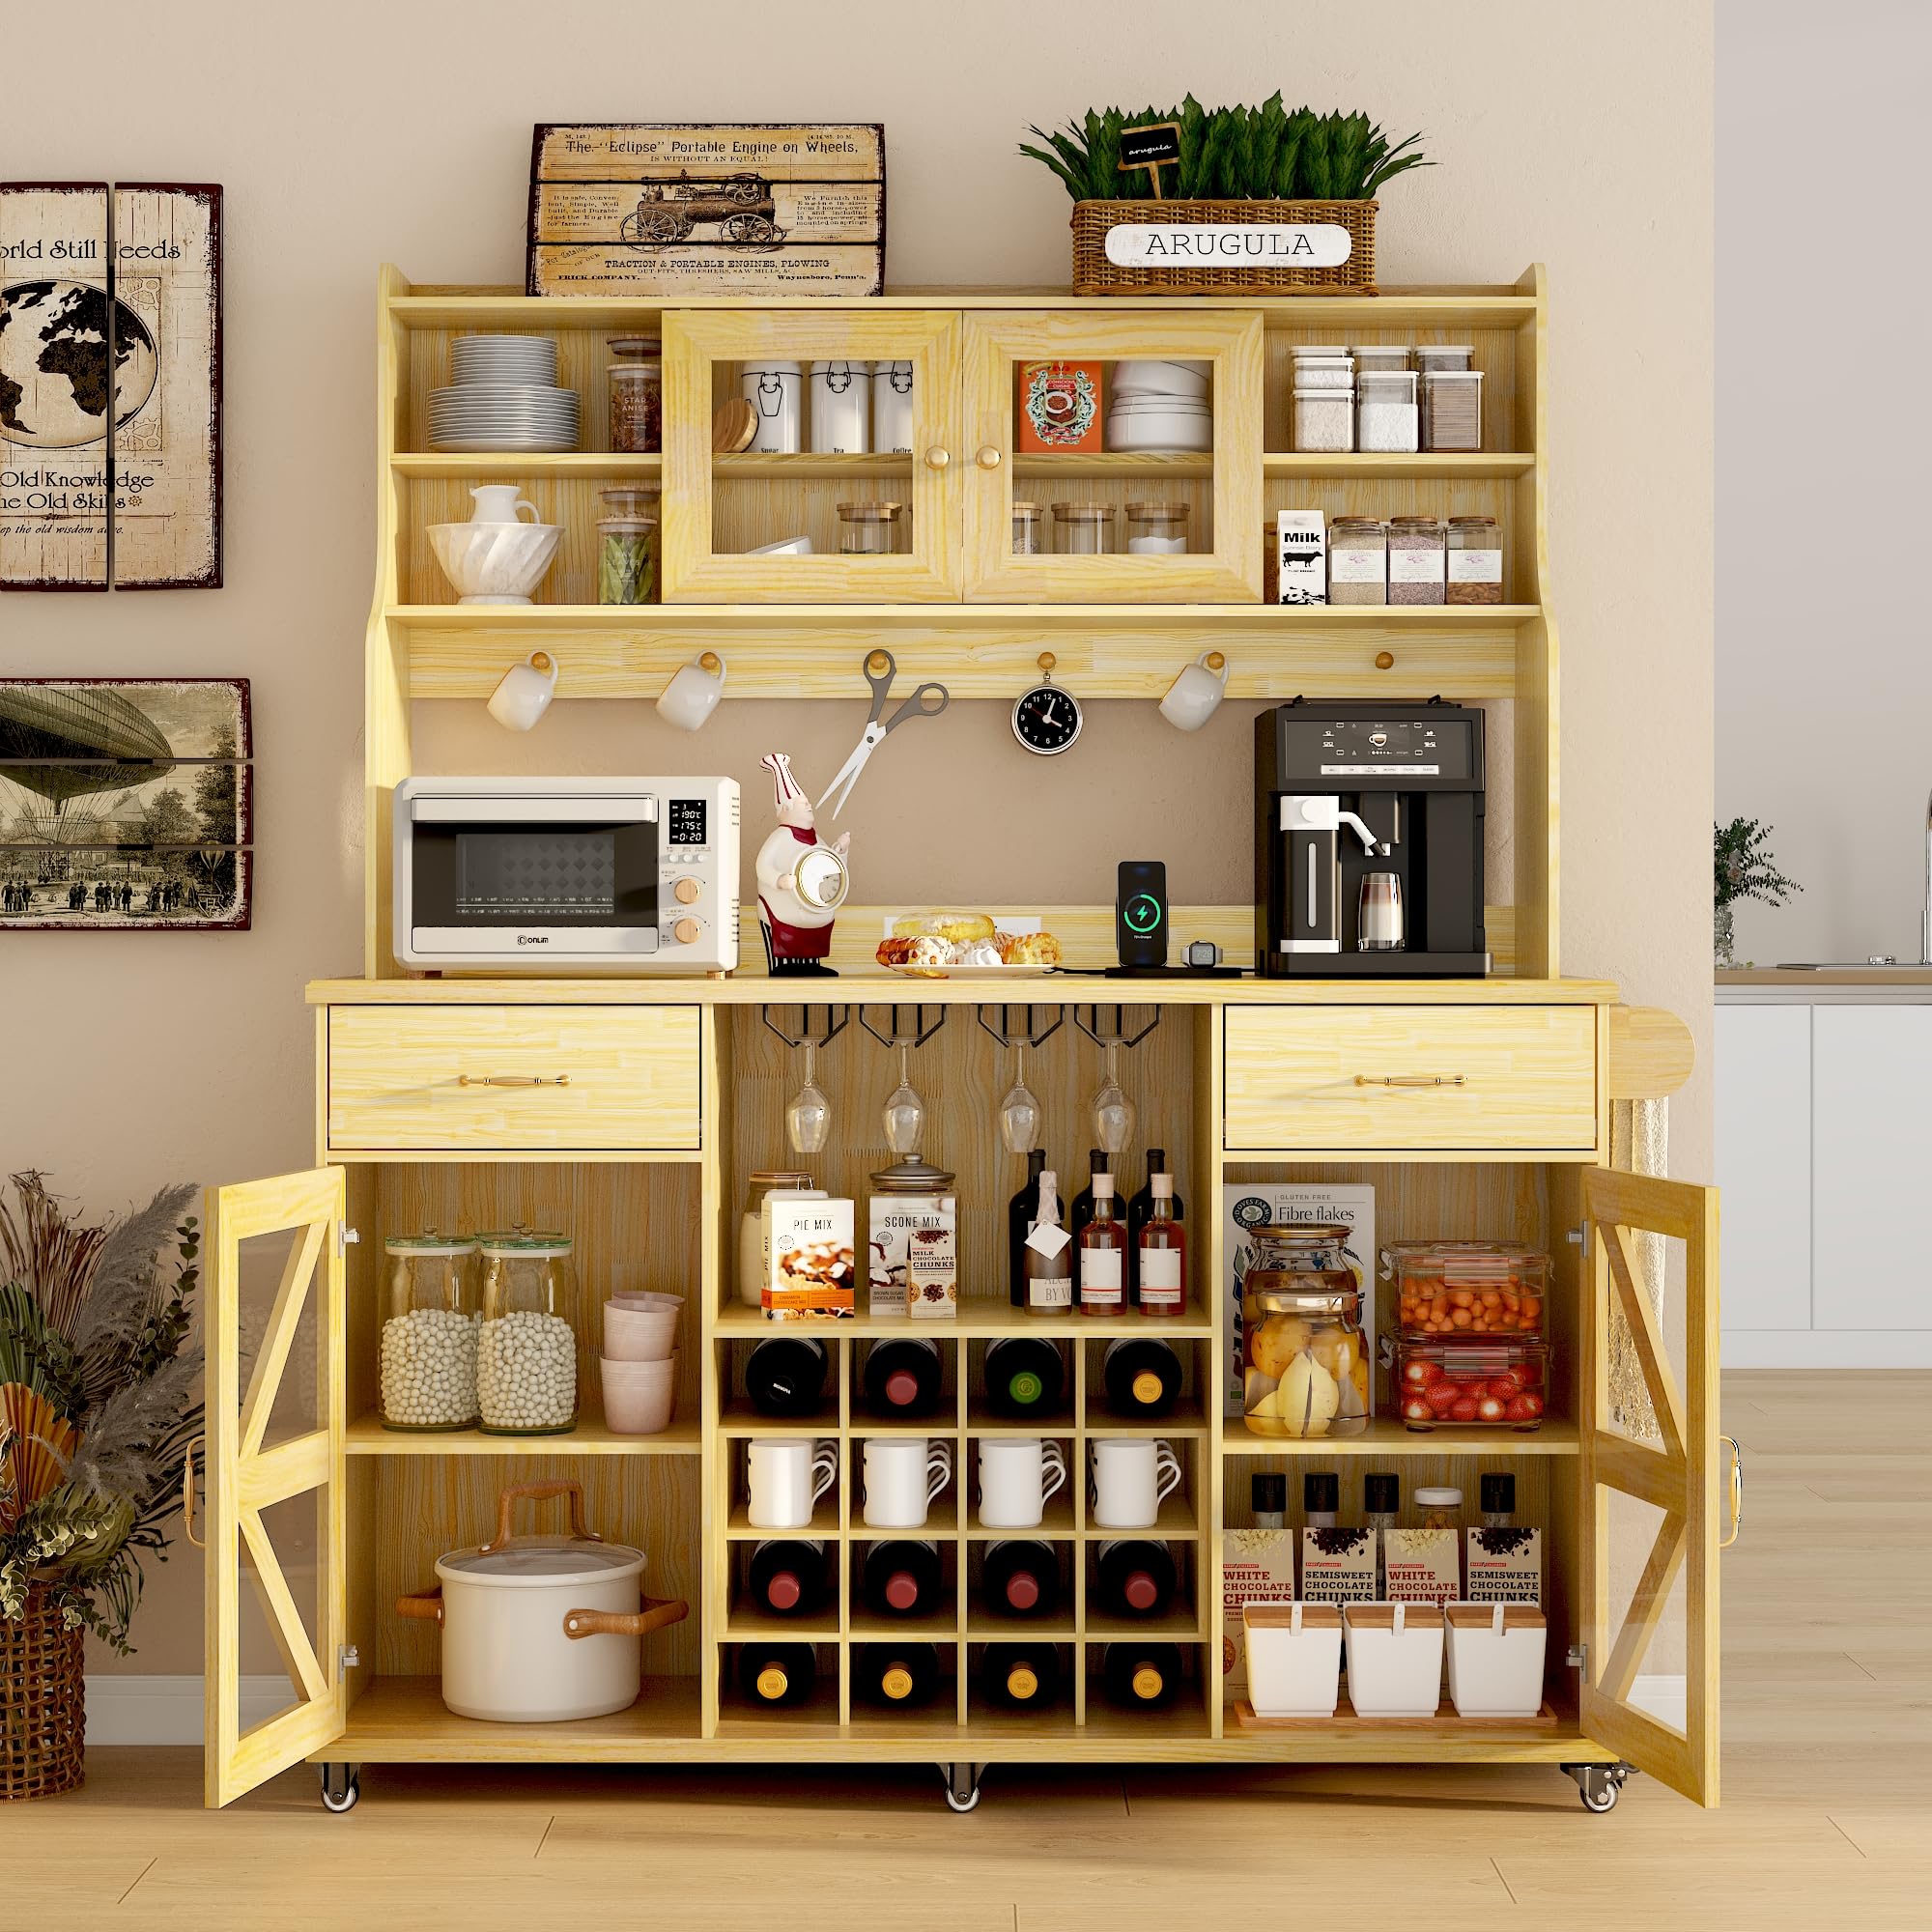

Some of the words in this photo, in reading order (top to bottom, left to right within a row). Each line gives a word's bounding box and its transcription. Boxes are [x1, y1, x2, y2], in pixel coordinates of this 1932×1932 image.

[671, 141, 725, 153] Portable
[732, 141, 777, 156] Engine
[782, 142, 798, 154] on
[806, 141, 858, 154] Wheels,
[1128, 144, 1173, 156] arugula
[49, 240, 97, 259] Still
[1145, 234, 1315, 255] ARUGULA
[605, 260, 657, 269] TRACTION
[727, 260, 778, 269] ENGINES,
[0, 470, 39, 487] Old
[27, 493, 67, 508] Old
[14, 525, 32, 534] the
[35, 525, 53, 533] old
[56, 525, 94, 534] wisdom
[1284, 533, 1321, 543] Milk
[679, 833, 702, 841] 0:20
[1235, 1199, 1254, 1215] DOVES
[1255, 1199, 1270, 1215] FARM
[1279, 1206, 1313, 1221] Fibre
[1317, 1206, 1355, 1221] flakes
[814, 1219, 832, 1231] MIX
[885, 1216, 918, 1228] SCONE
[923, 1216, 941, 1228] MIX
[1045, 1288, 1059, 1301] BY
[1223, 1571, 1270, 1580] WHITE
[1305, 1571, 1374, 1579] SEMISWEET
[1388, 1571, 1435, 1580] WHITE
[1470, 1571, 1539, 1579] SEMISWEET
[1223, 1582, 1292, 1591] CHOCOLATE
[1305, 1581, 1374, 1590] CHOCOLATE
[1389, 1582, 1458, 1591] CHOCOLATE
[1470, 1581, 1539, 1590] CHOCOLATE
[1223, 1594, 1292, 1604] CHUNKS
[1305, 1592, 1374, 1602] CHUNKS
[1389, 1594, 1458, 1603] CHUNKS
[1469, 1592, 1539, 1602] CHUNKS
